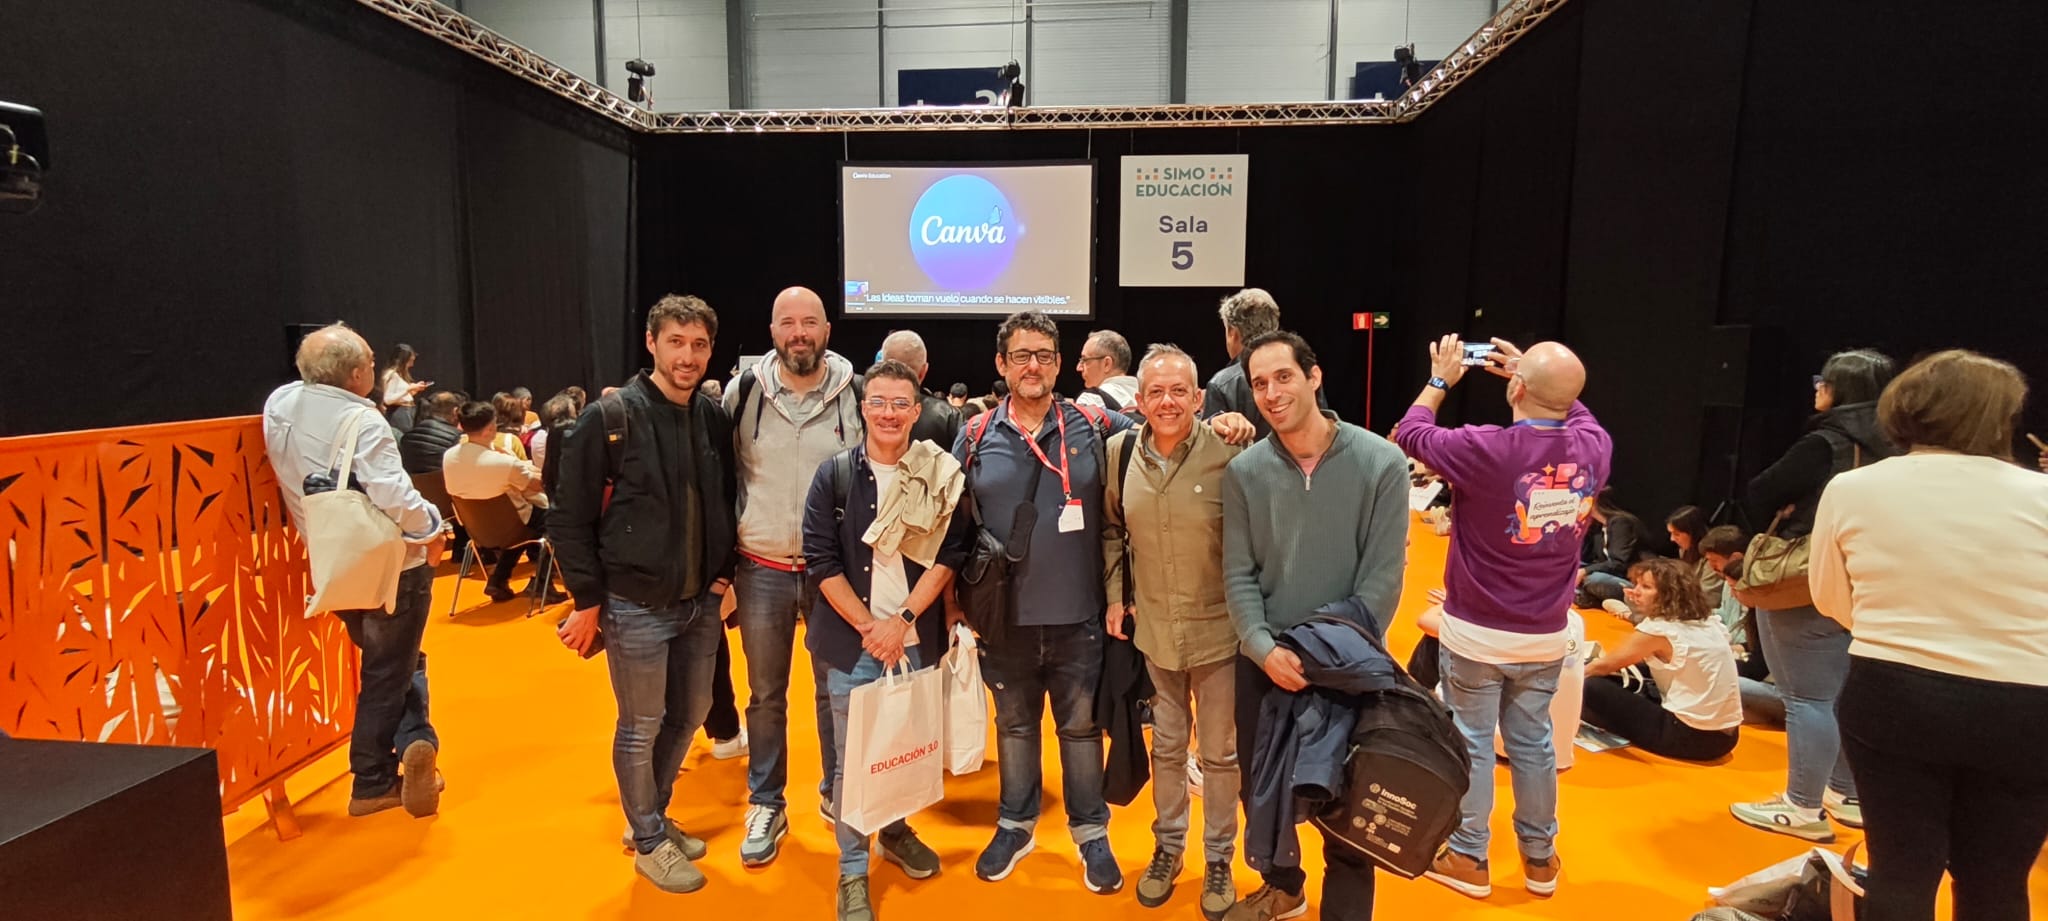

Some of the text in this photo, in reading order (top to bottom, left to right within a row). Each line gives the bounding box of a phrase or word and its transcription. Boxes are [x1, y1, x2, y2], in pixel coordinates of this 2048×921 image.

[1163, 167, 1205, 181] SIMO
[1136, 182, 1232, 197] EDUCACIÓN
[921, 215, 1006, 246] Canva
[1159, 215, 1208, 233] Sala
[1171, 241, 1194, 270] 5
[906, 293, 934, 303] toman
[935, 293, 959, 303] vuelo
[960, 294, 993, 304] cuando
[993, 296, 1005, 304] se
[1005, 294, 1033, 304] hacen
[870, 740, 939, 774] EDUCACIÓN 3.0
